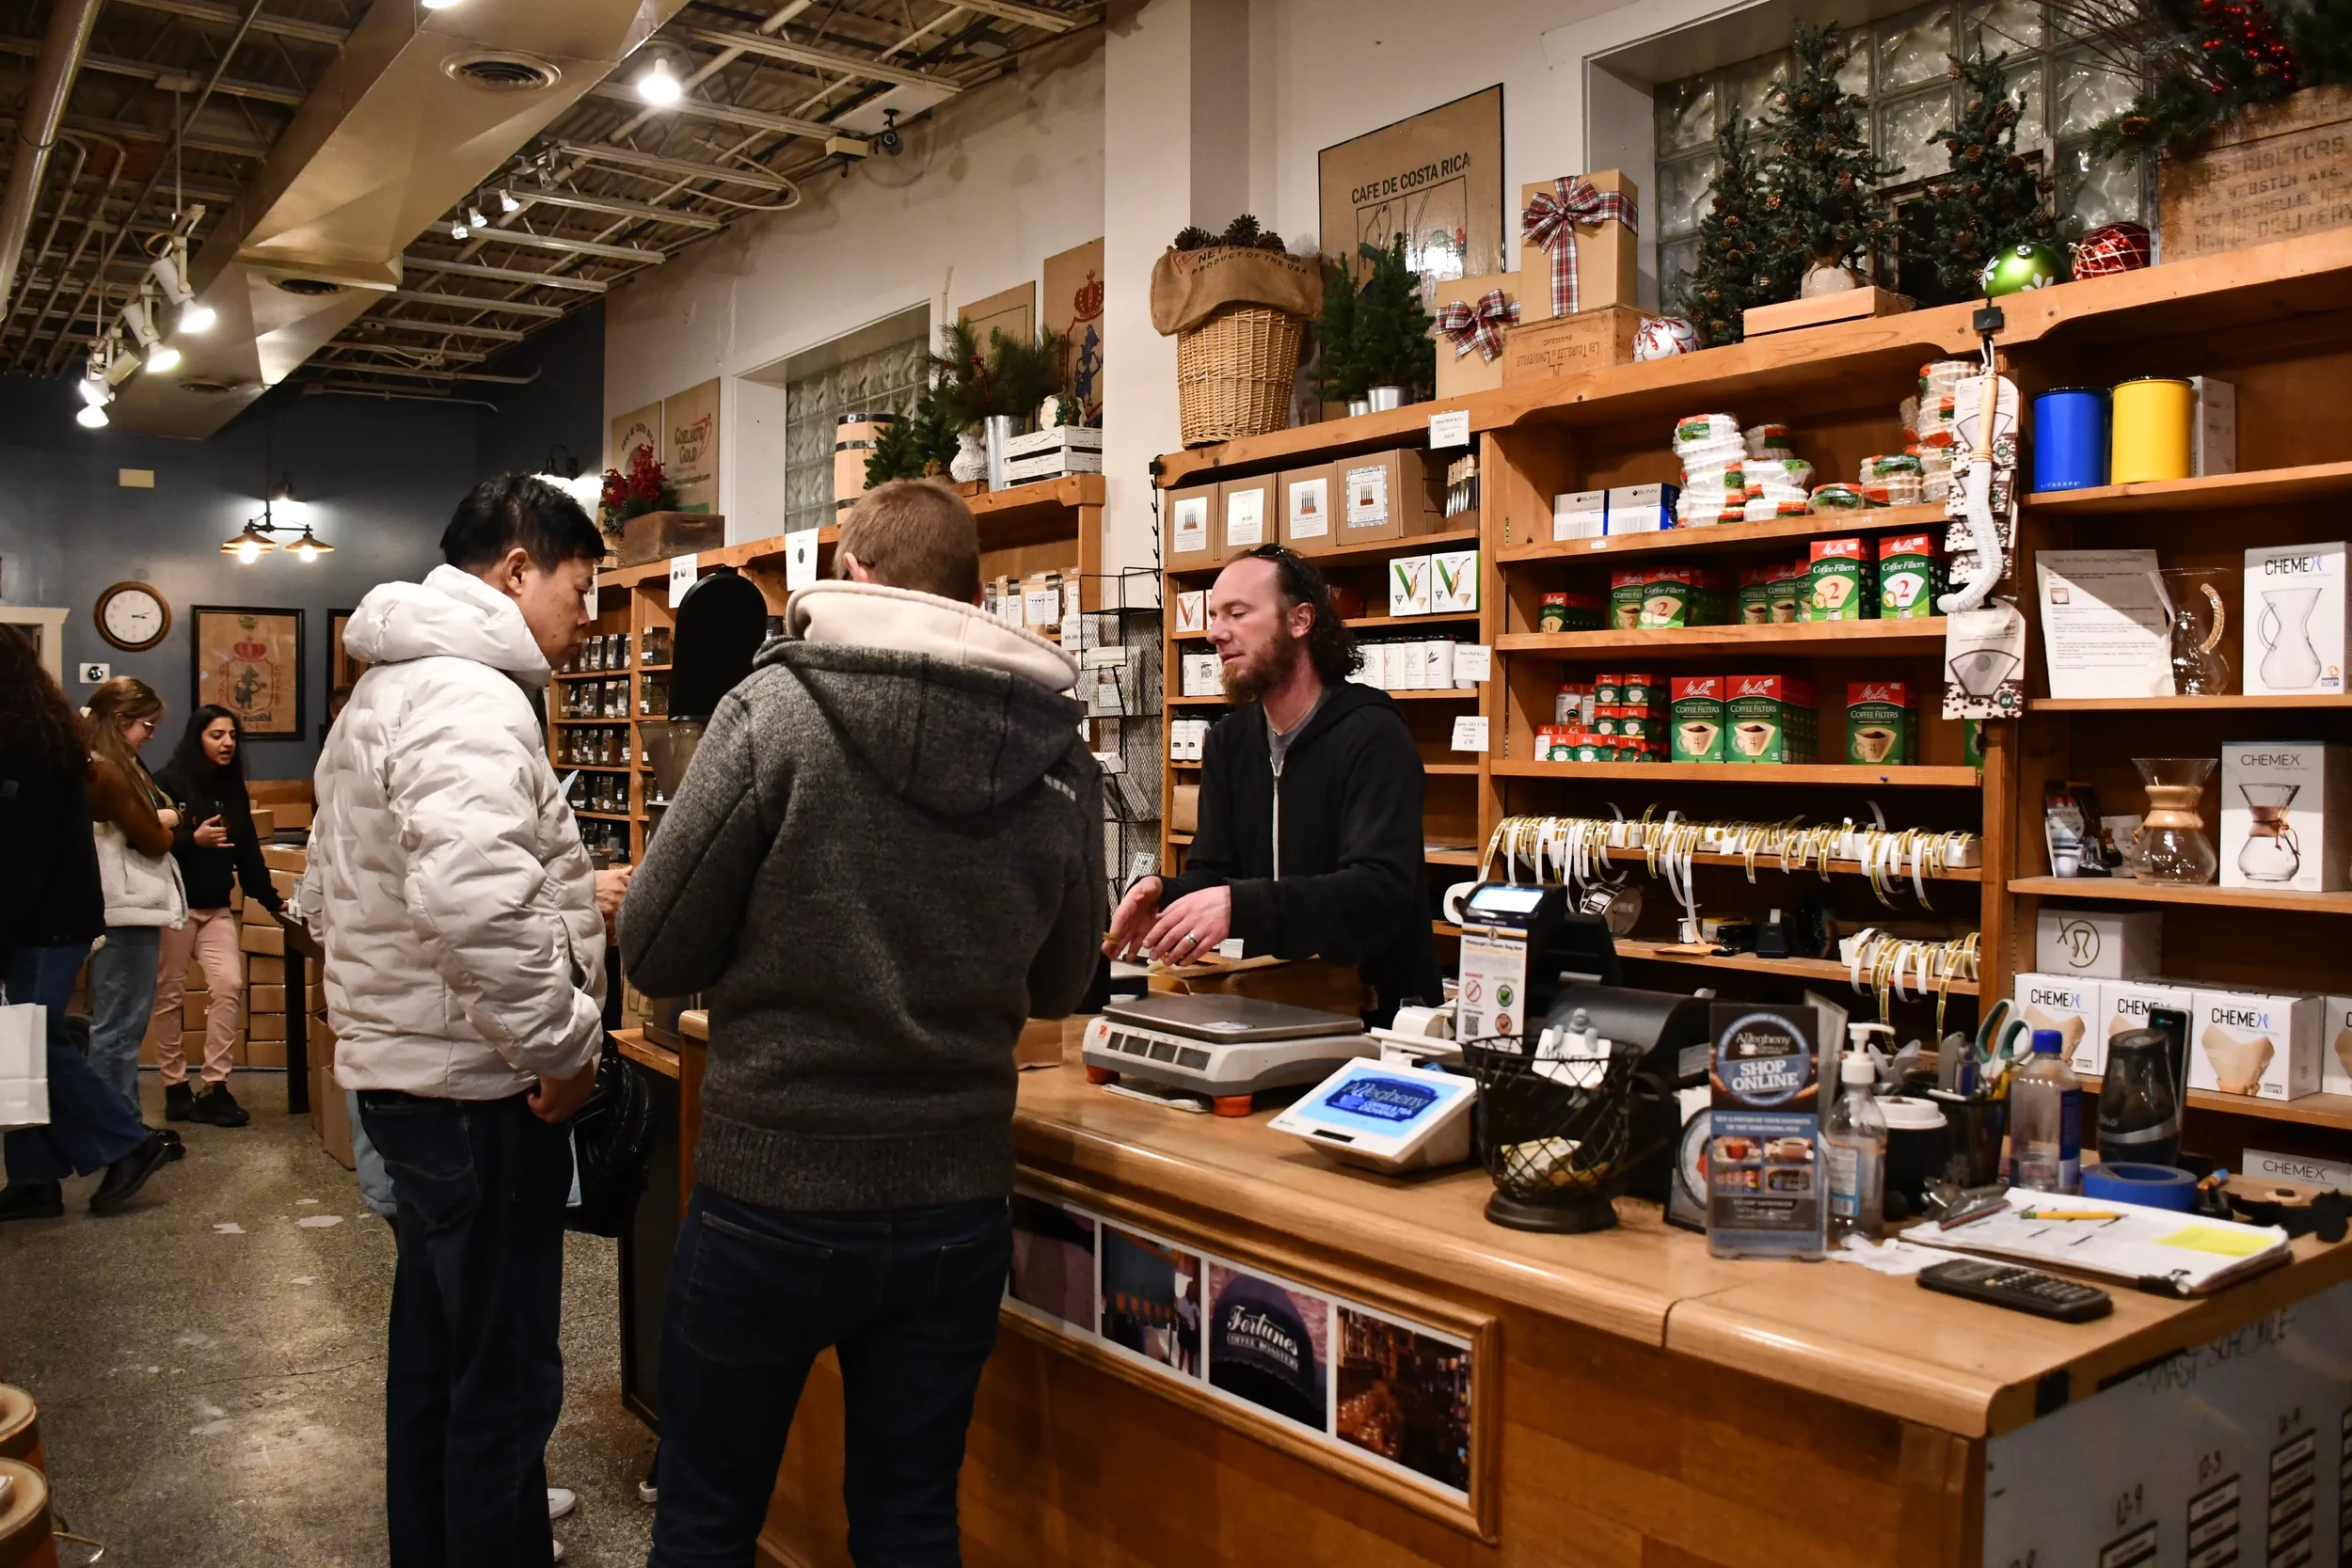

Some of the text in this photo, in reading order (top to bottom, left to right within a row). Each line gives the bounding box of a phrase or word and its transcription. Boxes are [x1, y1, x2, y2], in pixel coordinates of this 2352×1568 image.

[1351, 152, 1470, 204] CAFE DE COSTA RICA
[1191, 251, 1243, 275] PRODUCT
[1264, 255, 1283, 267] THE
[1287, 263, 1308, 275] USA
[1820, 542, 1847, 556] Melitta
[1889, 538, 1915, 553] Melitta
[1812, 563, 1856, 575] Coffee Filters
[1882, 561, 1926, 572] Coffee Filters
[2265, 556, 2322, 576] CHEMEX
[1645, 586, 1664, 595] Coffee
[1665, 586, 1686, 594] Filters
[1829, 582, 1839, 599] 2
[1899, 579, 1910, 598] 2
[1658, 602, 1668, 616] 2
[1682, 680, 1711, 696] Melitta
[1737, 678, 1768, 695] Melitta
[1858, 685, 1890, 701] Melitta
[1676, 705, 1696, 714] COFFEE
[1730, 705, 1777, 713] COFFEE FILTERS
[1851, 710, 1899, 719] COFFEE FILTERS
[1693, 736, 1700, 748] 4
[1750, 736, 1757, 748] 4
[1869, 743, 1877, 753] 4
[2240, 753, 2302, 767] CHEMEX
[2030, 989, 2081, 1009] CHEMEX
[2211, 1007, 2269, 1029] CHEMEX
[1736, 1032, 1791, 1049] Allegheny
[1740, 1059, 1788, 1077] SHOP
[1731, 1072, 1799, 1092] ONLINE
[1342, 1082, 1430, 1110] Allegheny
[2263, 1160, 2327, 1180] CHEMEX
[1227, 1305, 1298, 1356] Fortunes
